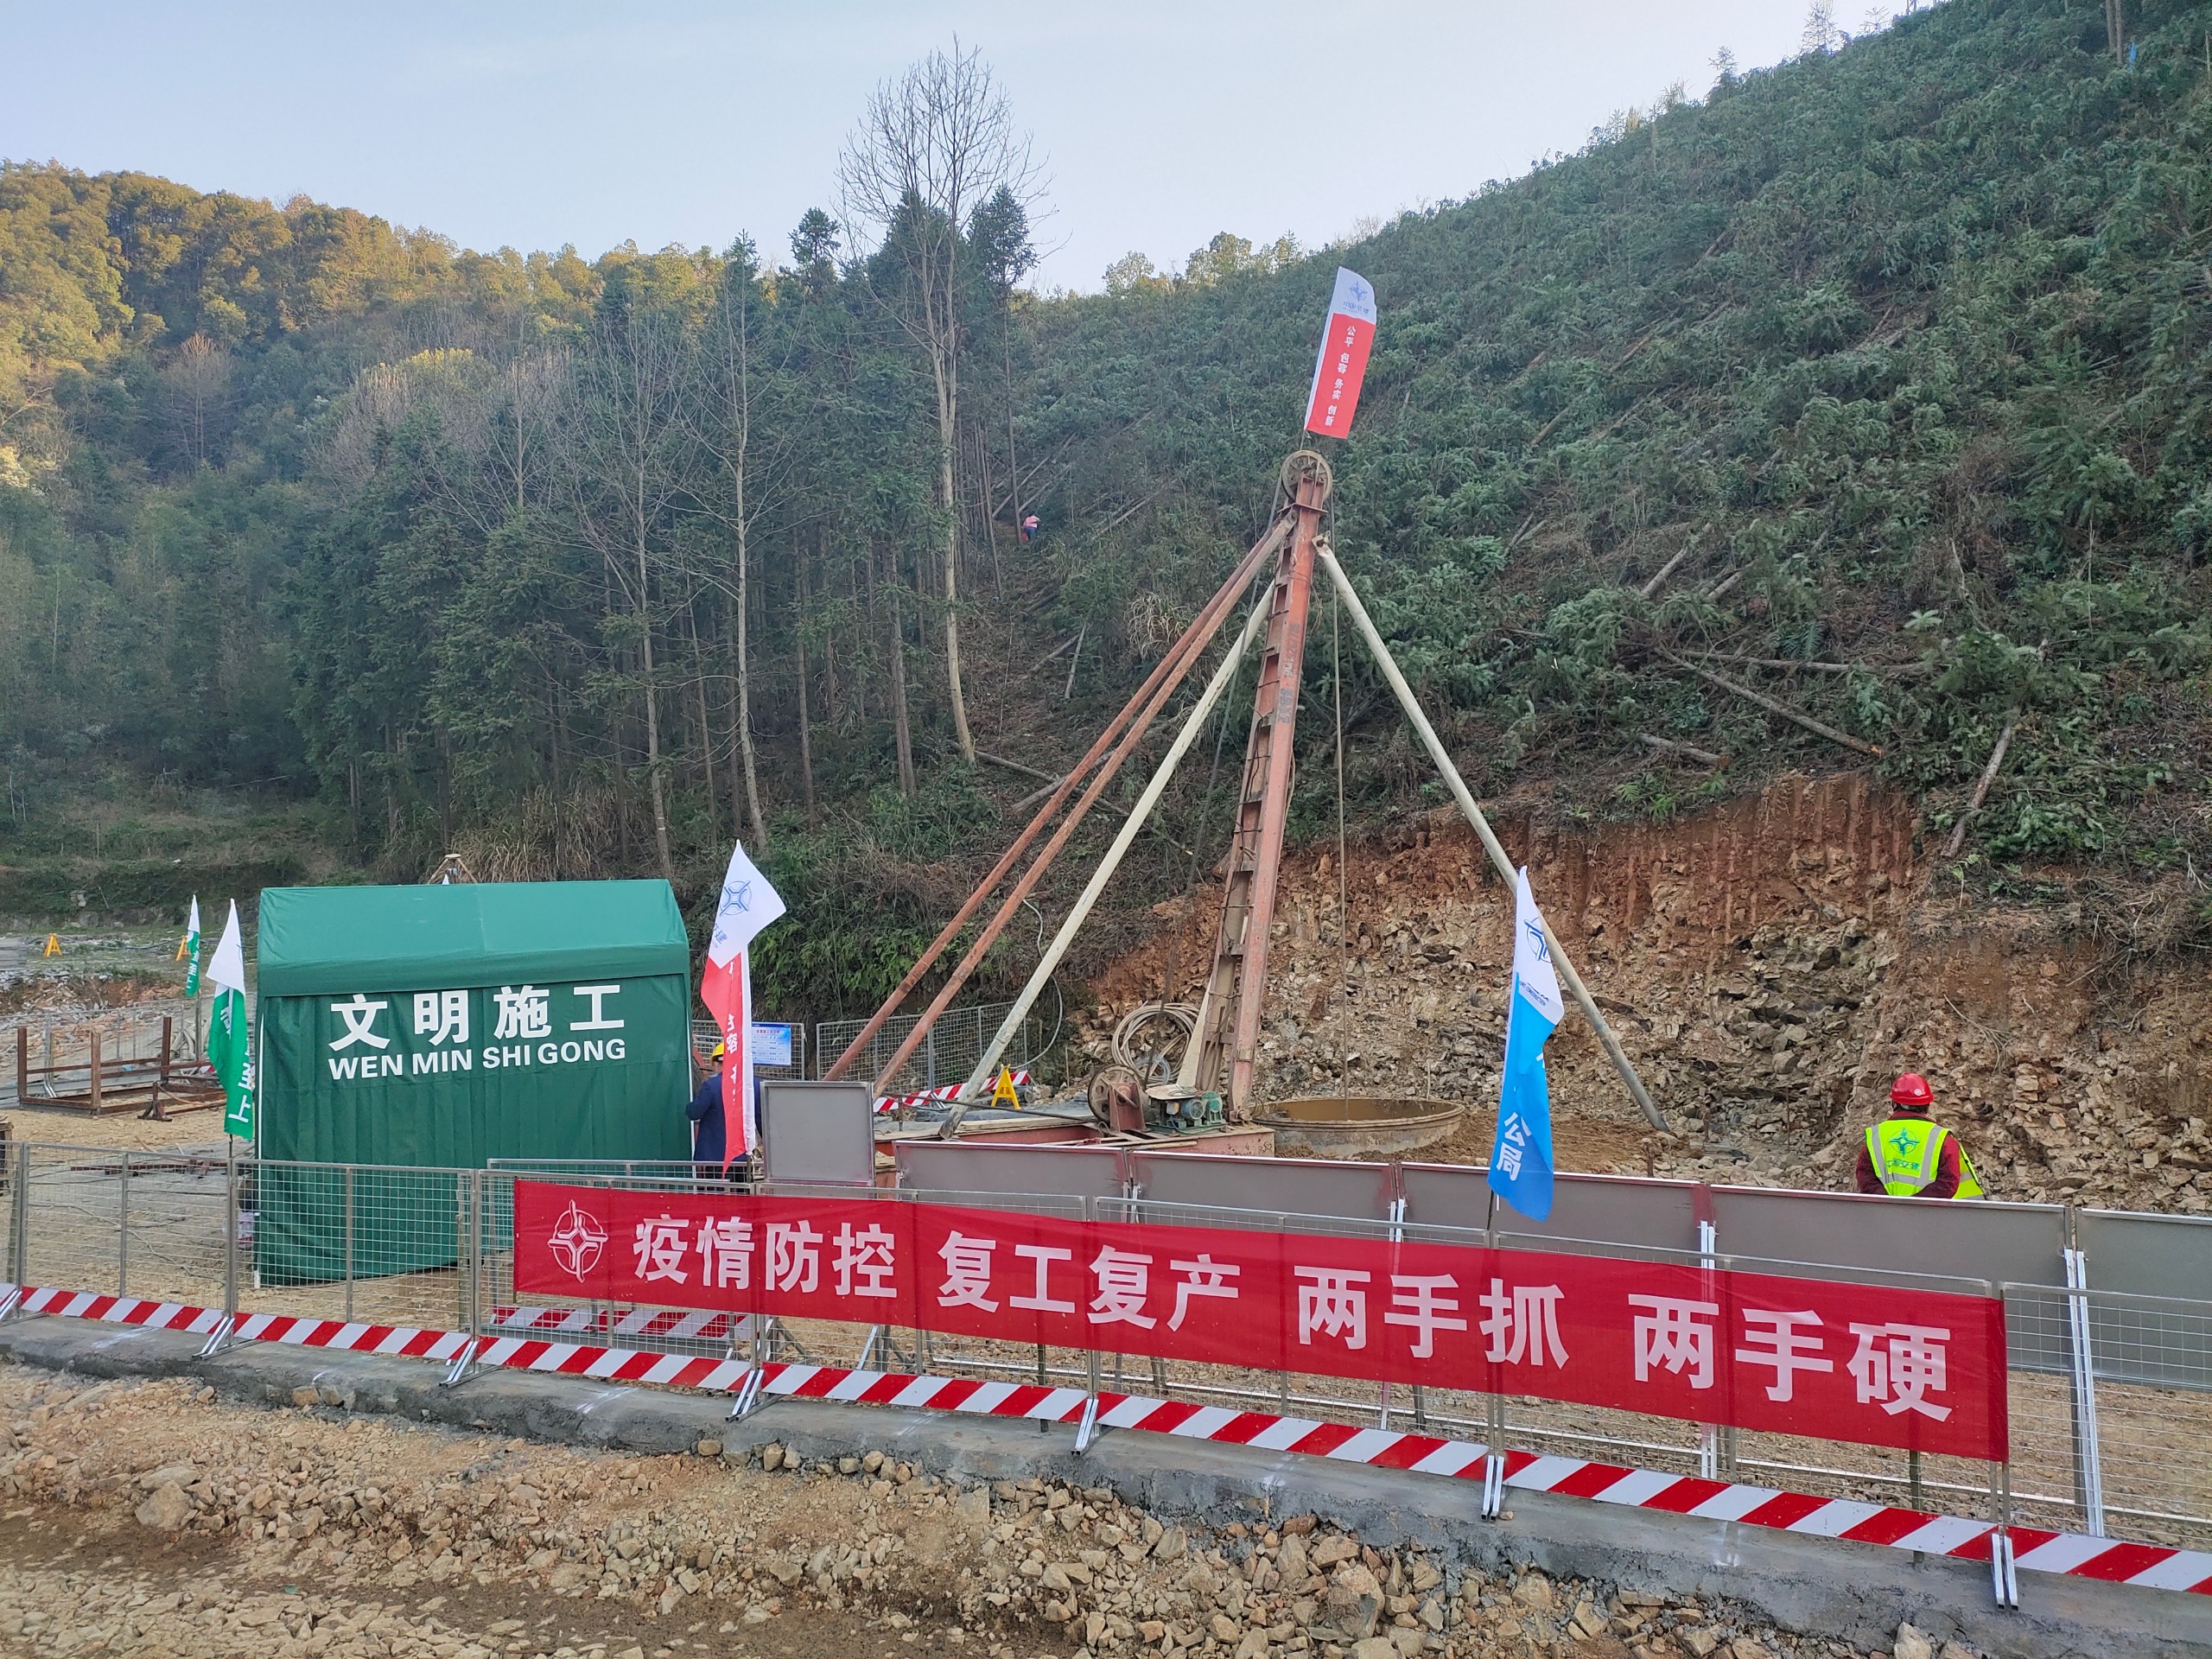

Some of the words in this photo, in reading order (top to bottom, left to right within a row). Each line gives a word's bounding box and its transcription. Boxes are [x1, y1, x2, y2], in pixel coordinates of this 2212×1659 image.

[1344, 326, 1357, 347] 公平
[1337, 353, 1351, 374] 包容
[1332, 378, 1344, 400] 务实
[1325, 404, 1338, 427] 创新
[328, 985, 625, 1052] 文明施工
[328, 1054, 403, 1080] WEN
[412, 1050, 473, 1075] MIN
[482, 1045, 531, 1069] SHI
[537, 1039, 626, 1065] GONG
[632, 1213, 897, 1298] 疫情防控
[938, 1230, 1241, 1332] 复工复产
[1294, 1265, 1570, 1370] 两手抓
[1628, 1294, 1953, 1422] 两手硬
